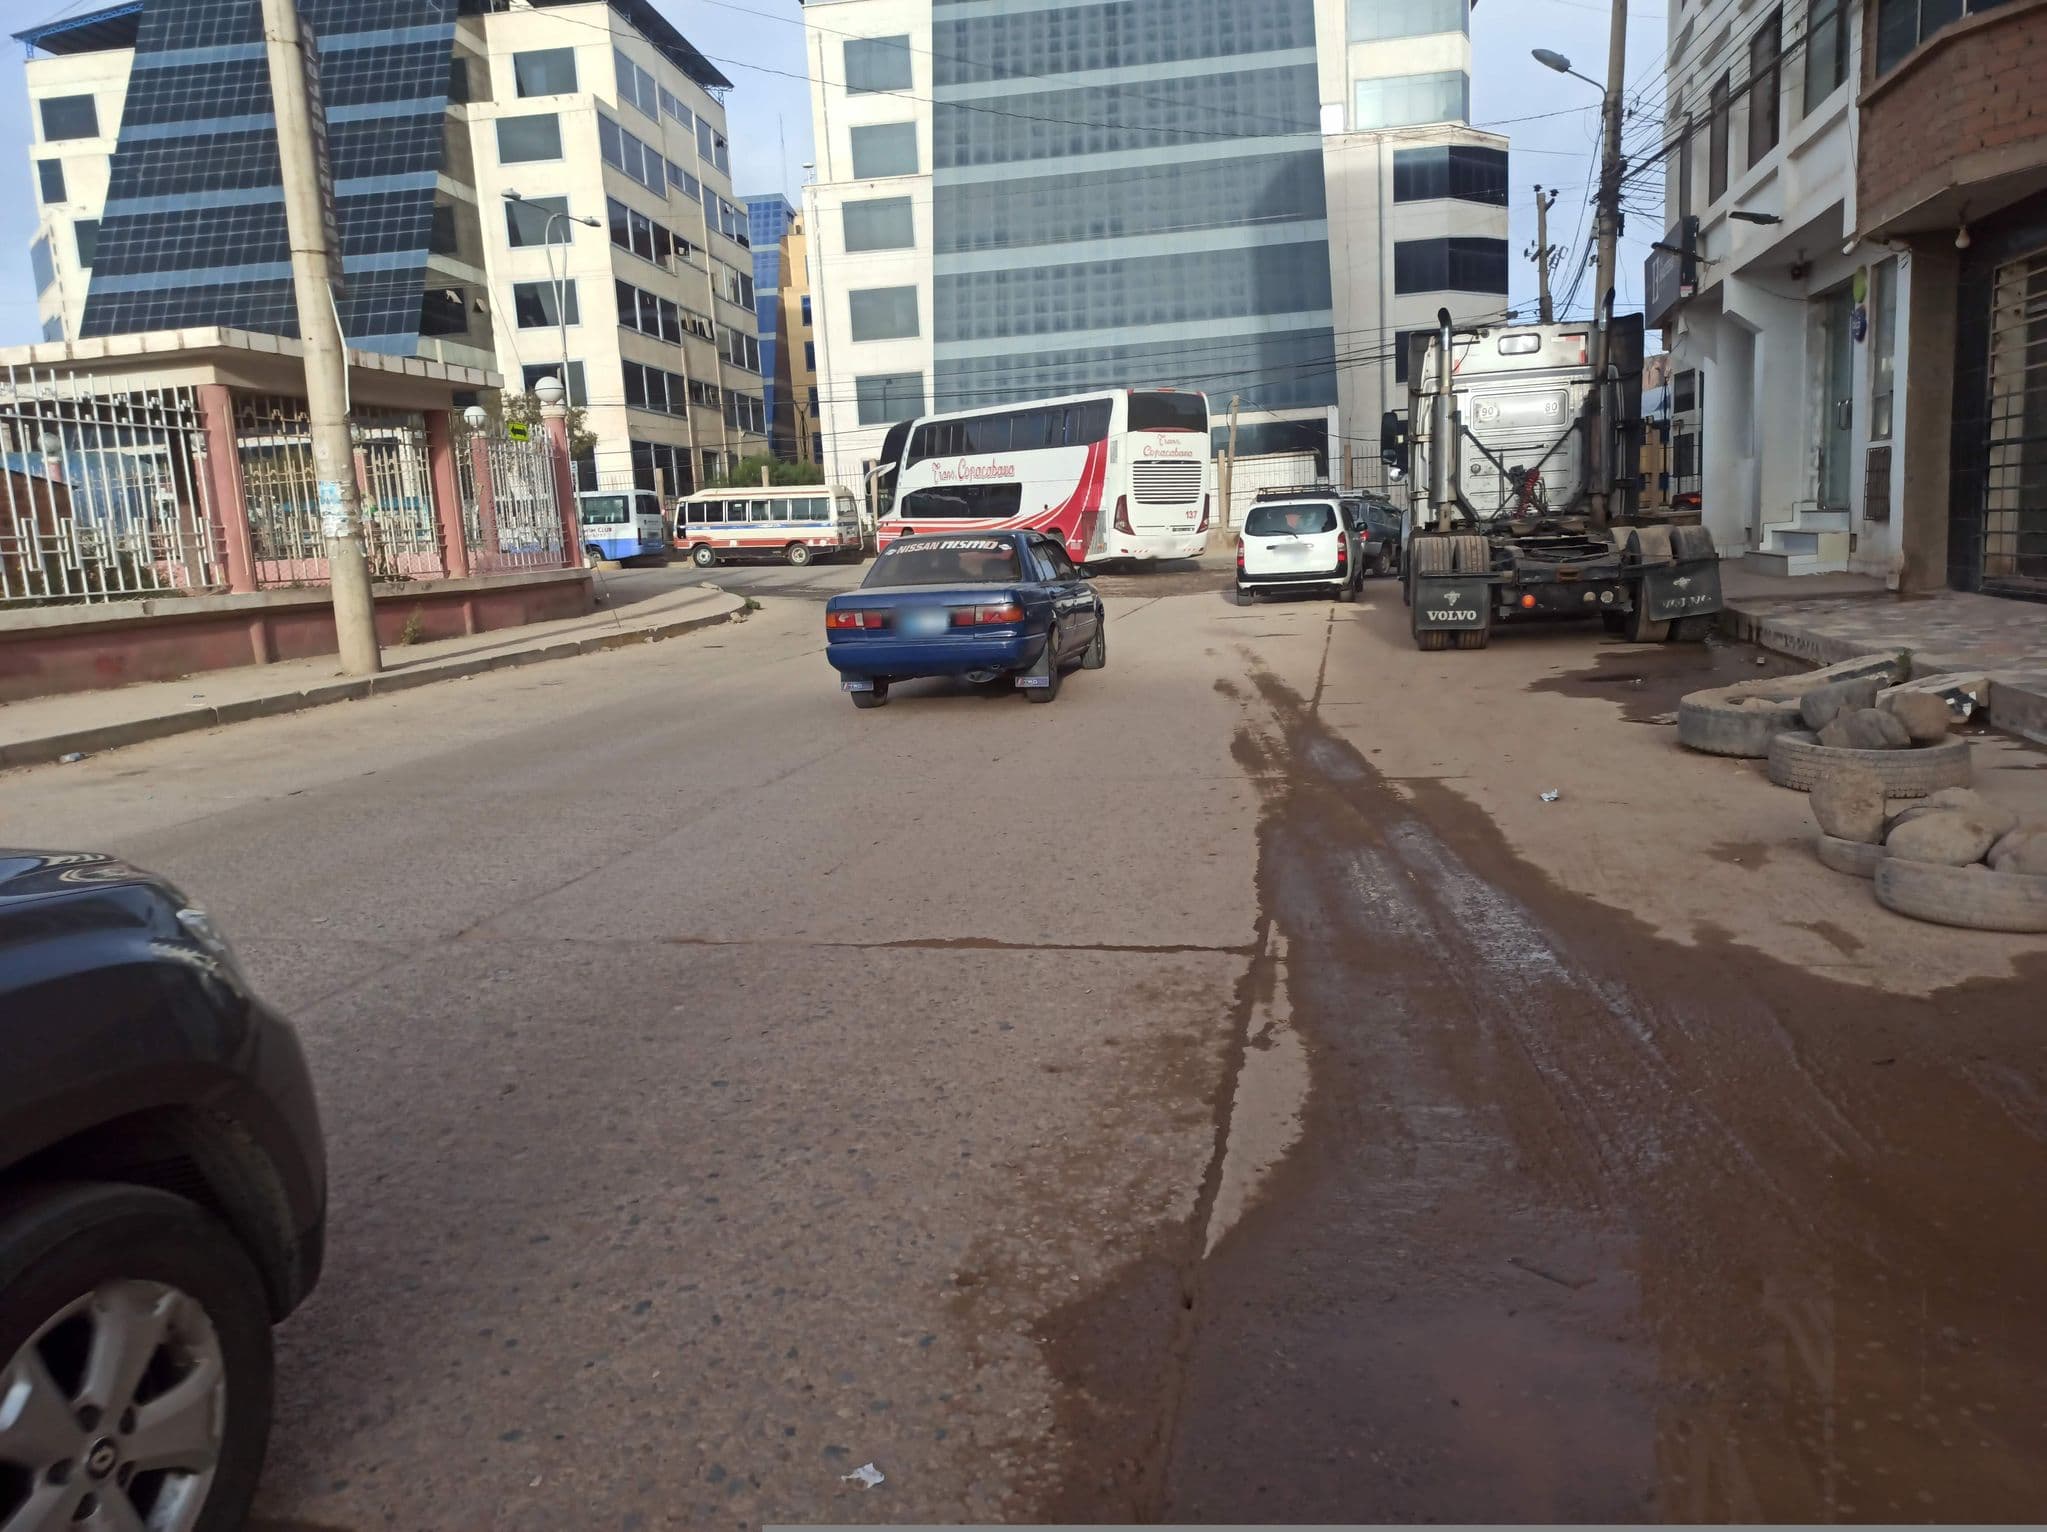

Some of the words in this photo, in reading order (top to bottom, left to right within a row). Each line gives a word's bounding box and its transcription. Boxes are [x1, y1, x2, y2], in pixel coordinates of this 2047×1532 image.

[957, 456, 1016, 483] Copacabana
[896, 541, 939, 554] NISSAN
[1426, 610, 1477, 621] VOLVO
